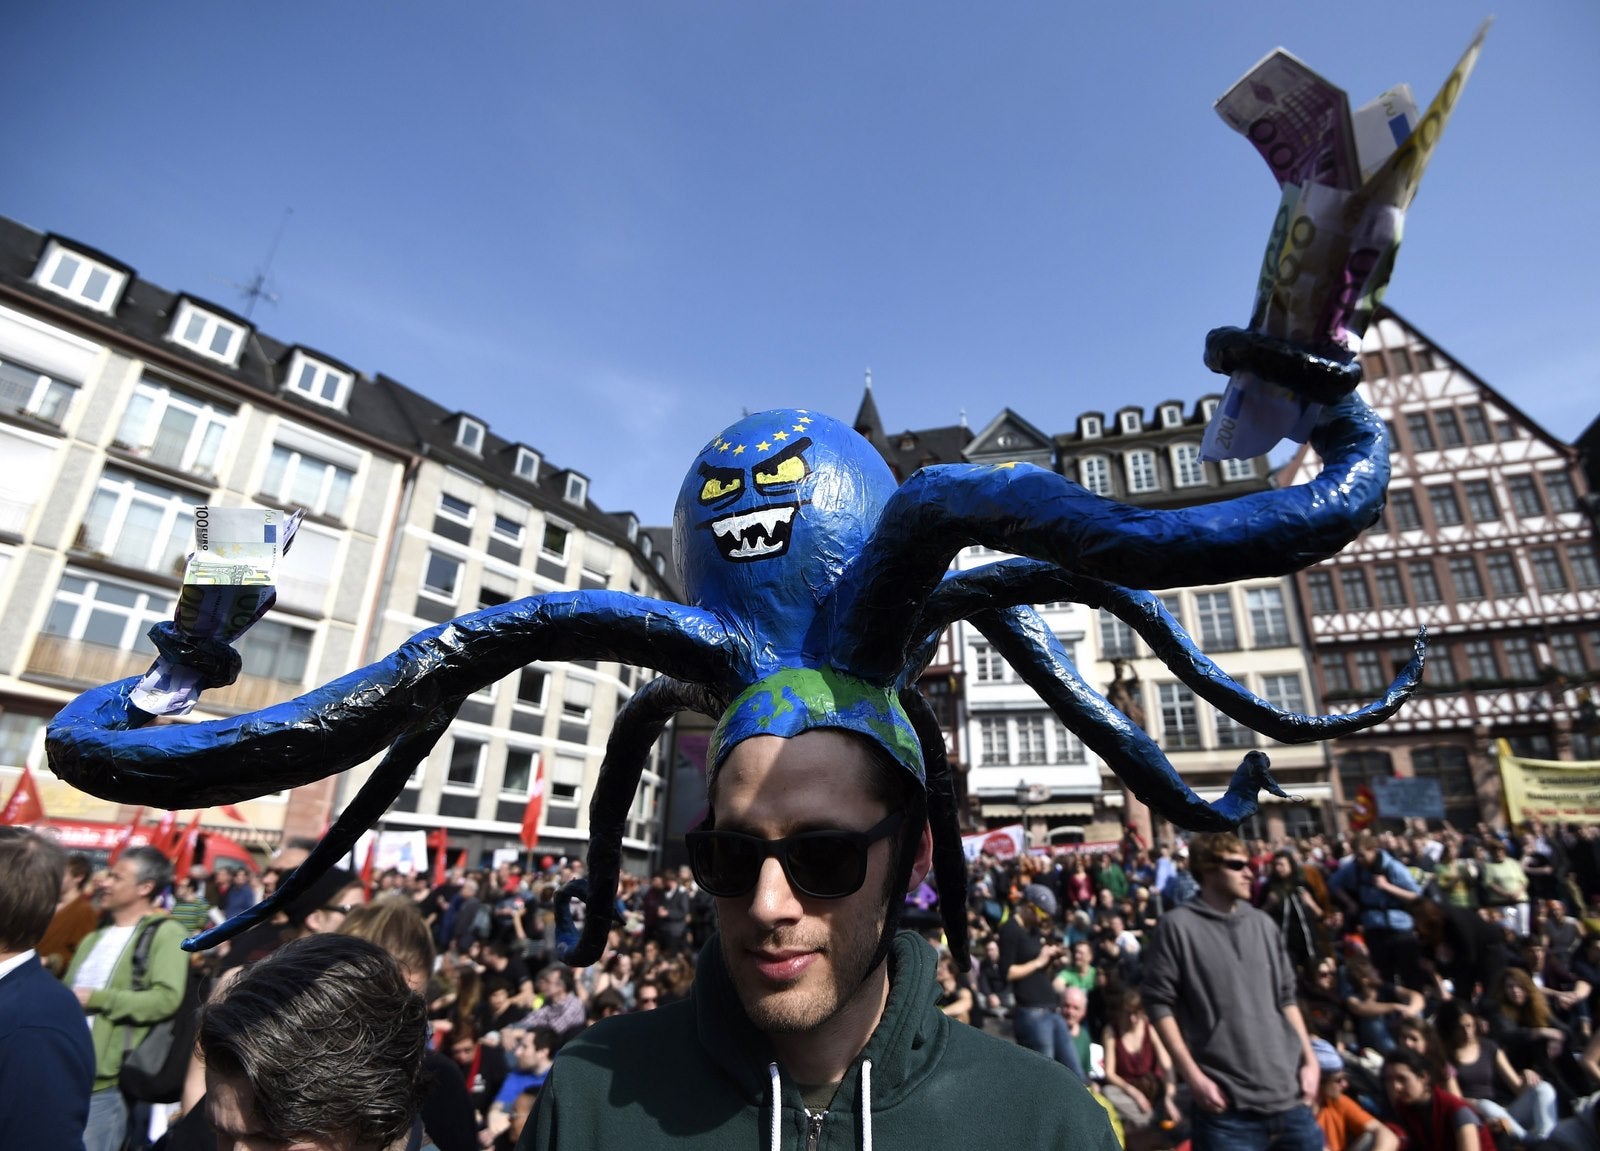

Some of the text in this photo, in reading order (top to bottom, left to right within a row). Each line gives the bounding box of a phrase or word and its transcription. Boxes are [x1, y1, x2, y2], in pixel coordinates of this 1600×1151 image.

[1216, 418, 1236, 450] 200
[196, 505, 209, 551] 100 EURO
